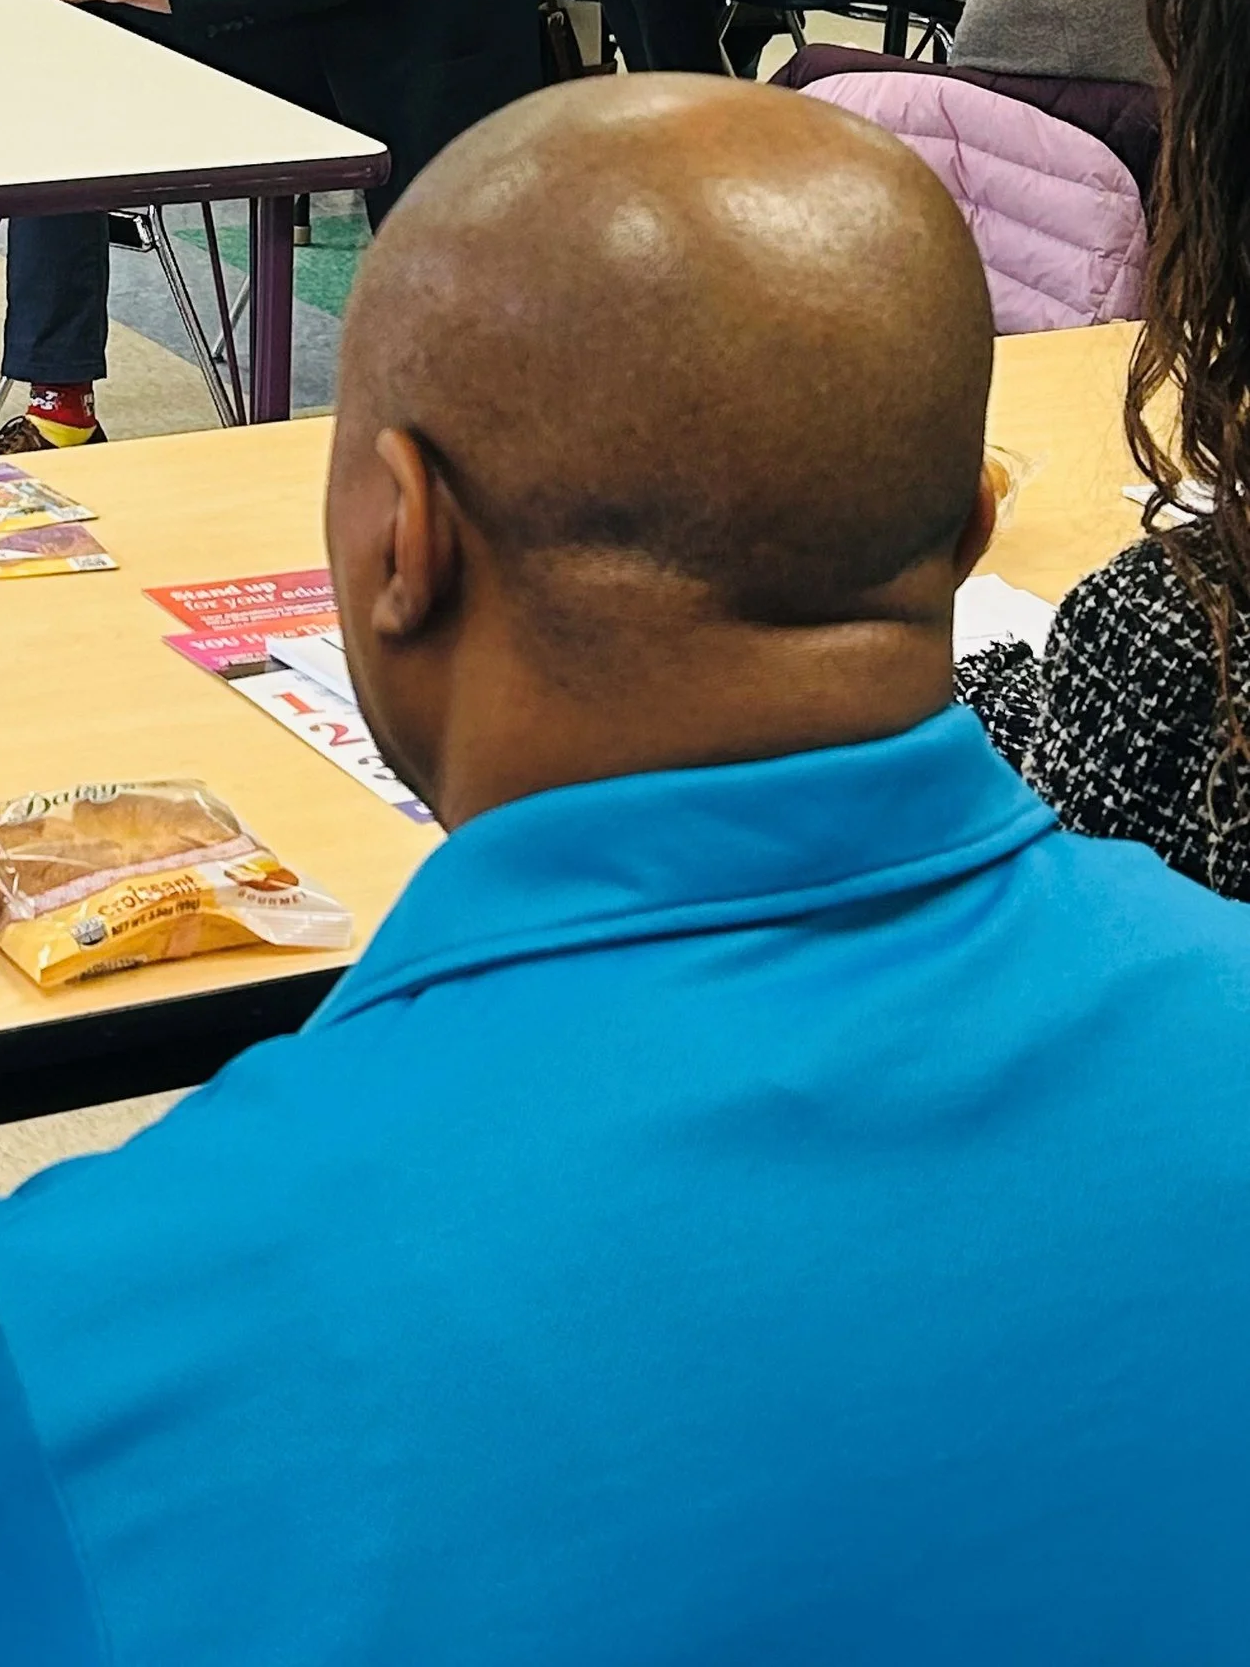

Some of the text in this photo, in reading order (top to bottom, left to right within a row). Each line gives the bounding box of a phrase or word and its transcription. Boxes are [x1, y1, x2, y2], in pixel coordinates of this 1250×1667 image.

[170, 580, 278, 602] Stand up
[183, 599, 219, 612] for
[223, 592, 276, 611] your
[271, 691, 327, 718] 1
[308, 721, 370, 748] 2
